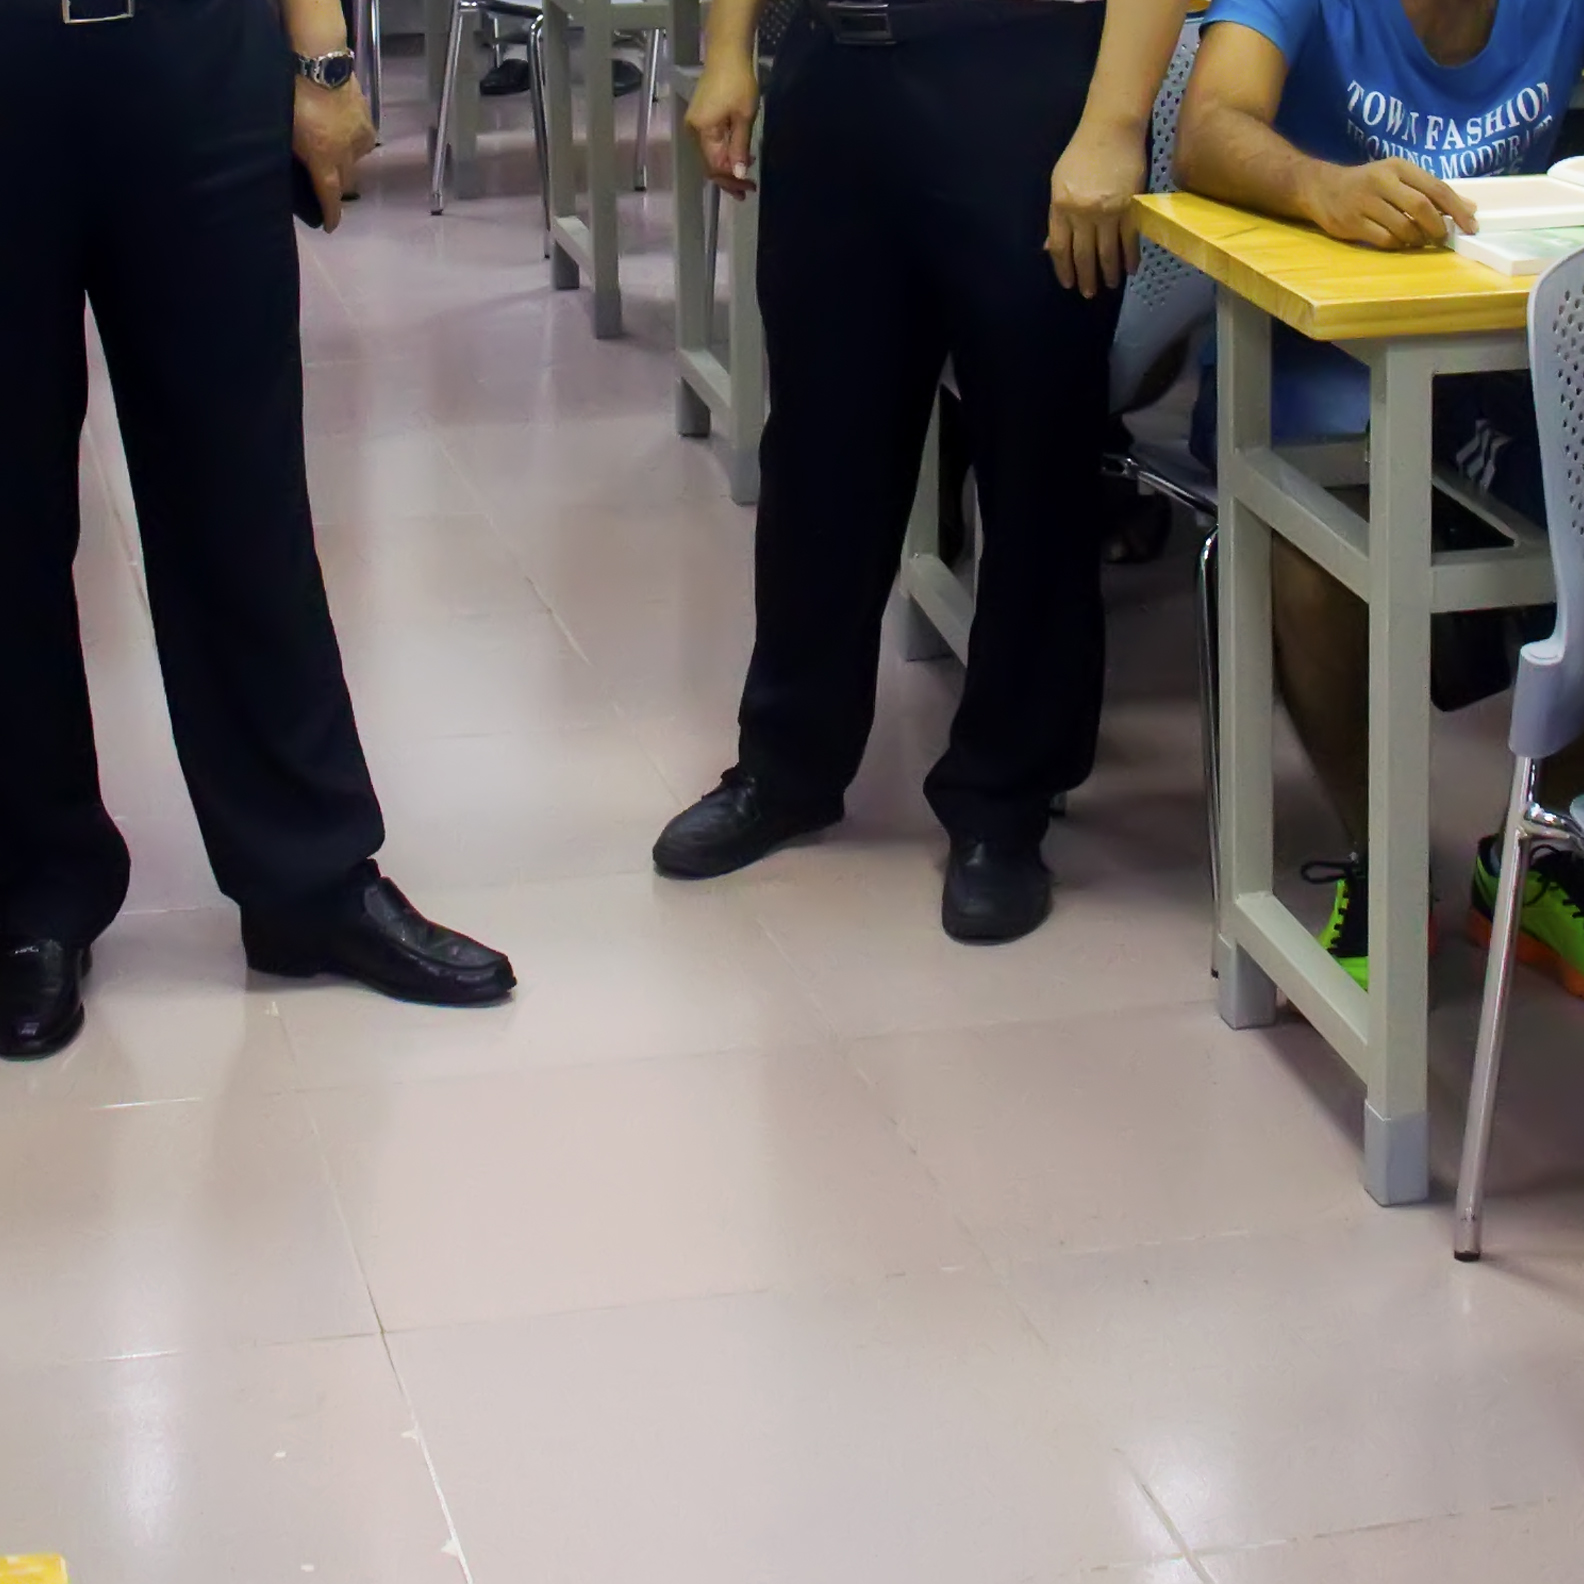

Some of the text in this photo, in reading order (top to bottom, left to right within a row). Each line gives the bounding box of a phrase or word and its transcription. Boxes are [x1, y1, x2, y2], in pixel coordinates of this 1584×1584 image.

[1347, 79, 1550, 151] TOWN FASHION
[1439, 114, 1553, 180] MODER
